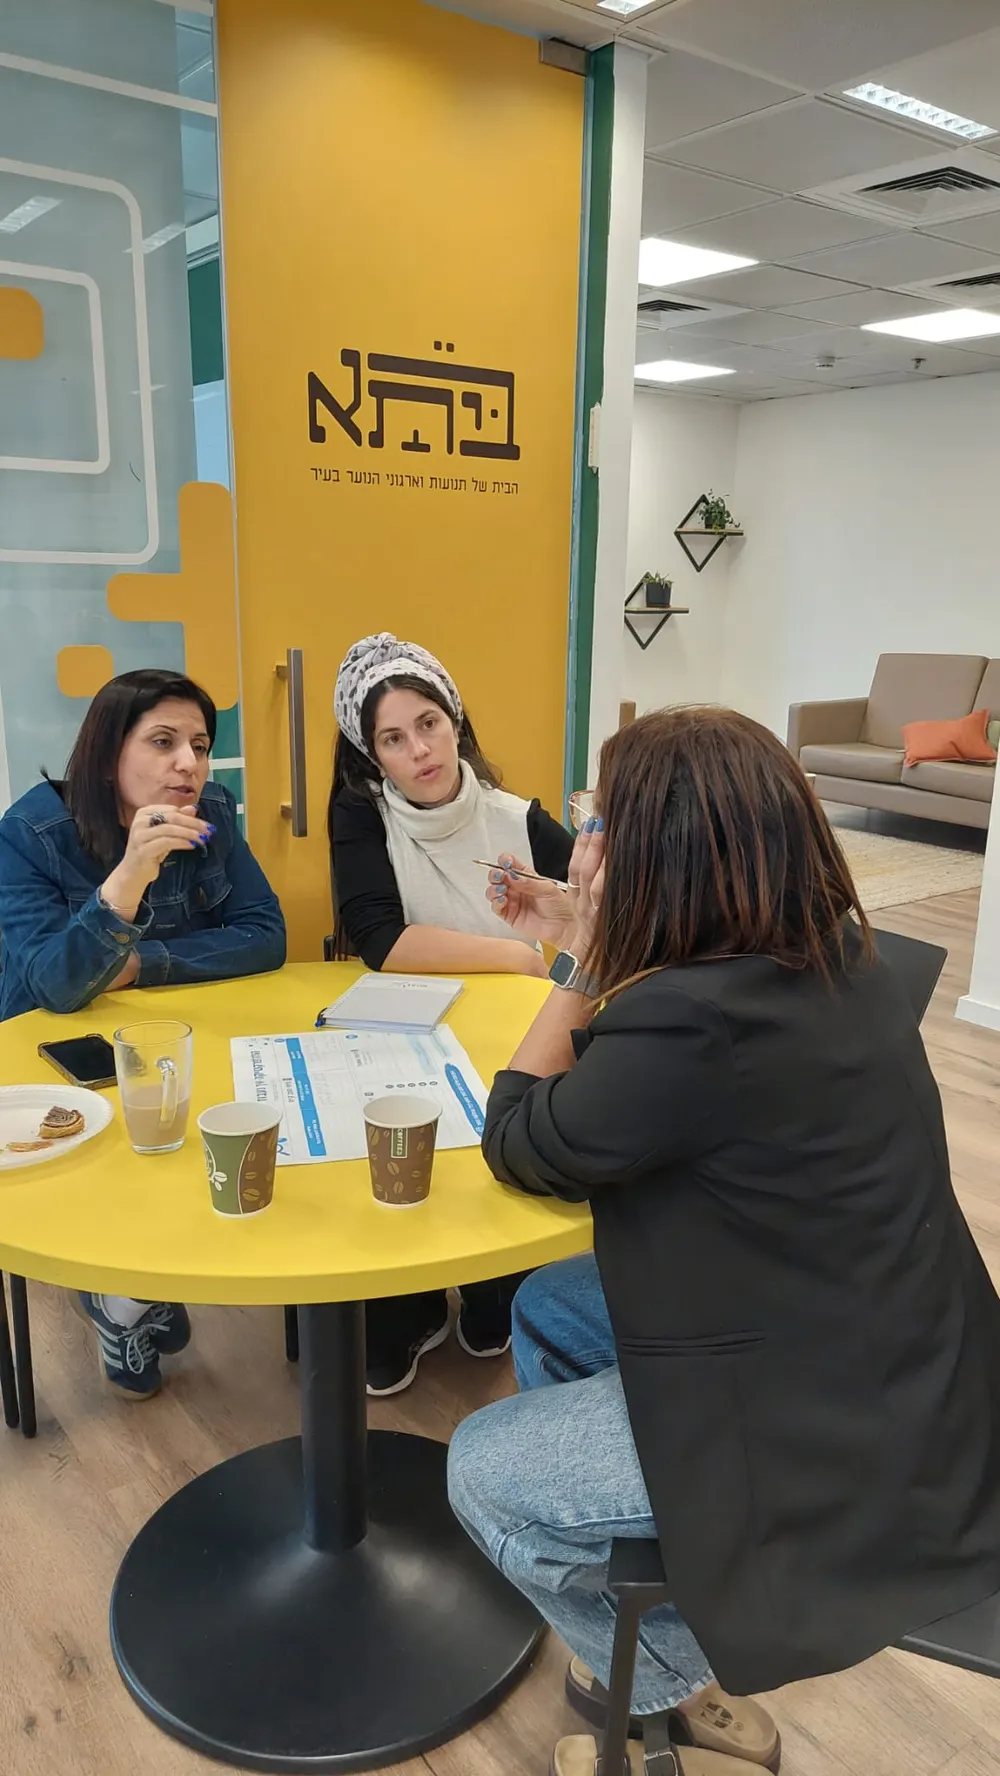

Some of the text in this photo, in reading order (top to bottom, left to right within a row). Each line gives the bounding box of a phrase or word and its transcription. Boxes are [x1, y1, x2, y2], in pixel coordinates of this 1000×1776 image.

[310, 467, 519, 495] הבית של תנועות וארגוני הנוער בעיר
